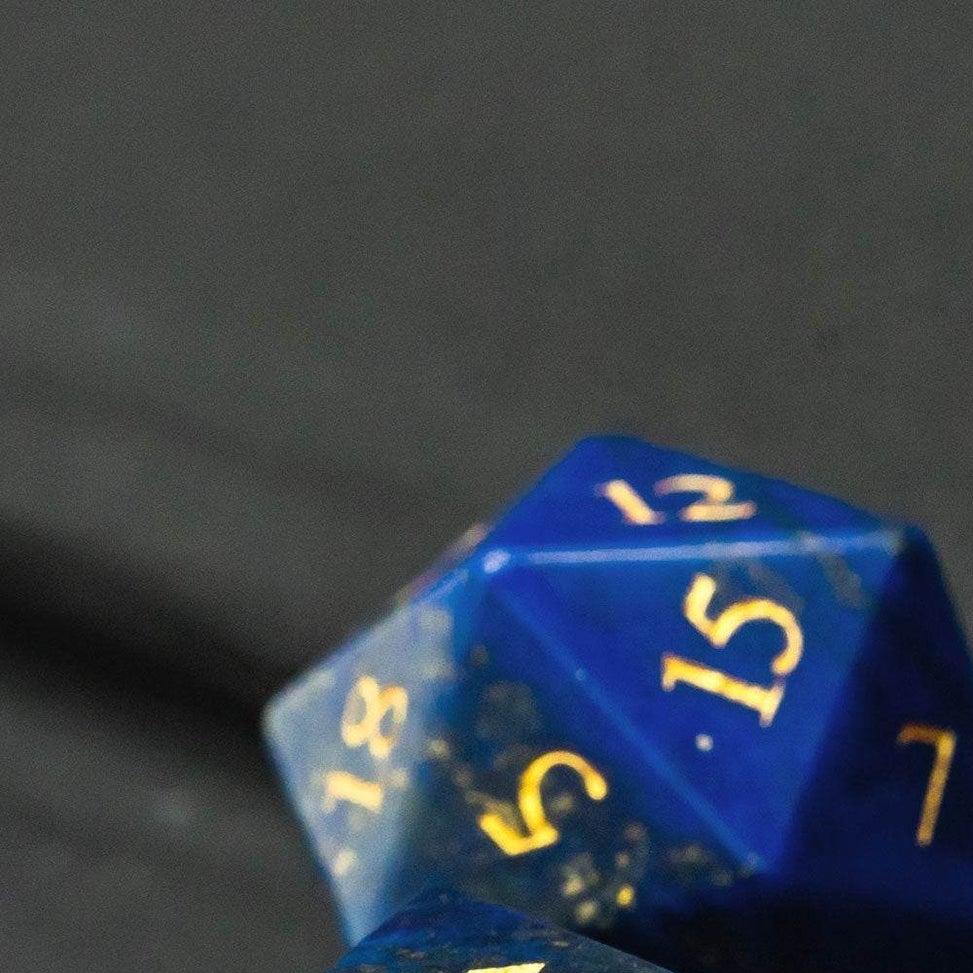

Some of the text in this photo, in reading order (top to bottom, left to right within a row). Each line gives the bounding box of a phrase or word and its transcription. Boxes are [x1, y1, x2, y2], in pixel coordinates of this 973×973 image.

[597, 471, 758, 526] 12
[660, 574, 806, 727] 15
[323, 675, 409, 814] 18
[478, 750, 608, 856] 5
[895, 722, 956, 848] 7
